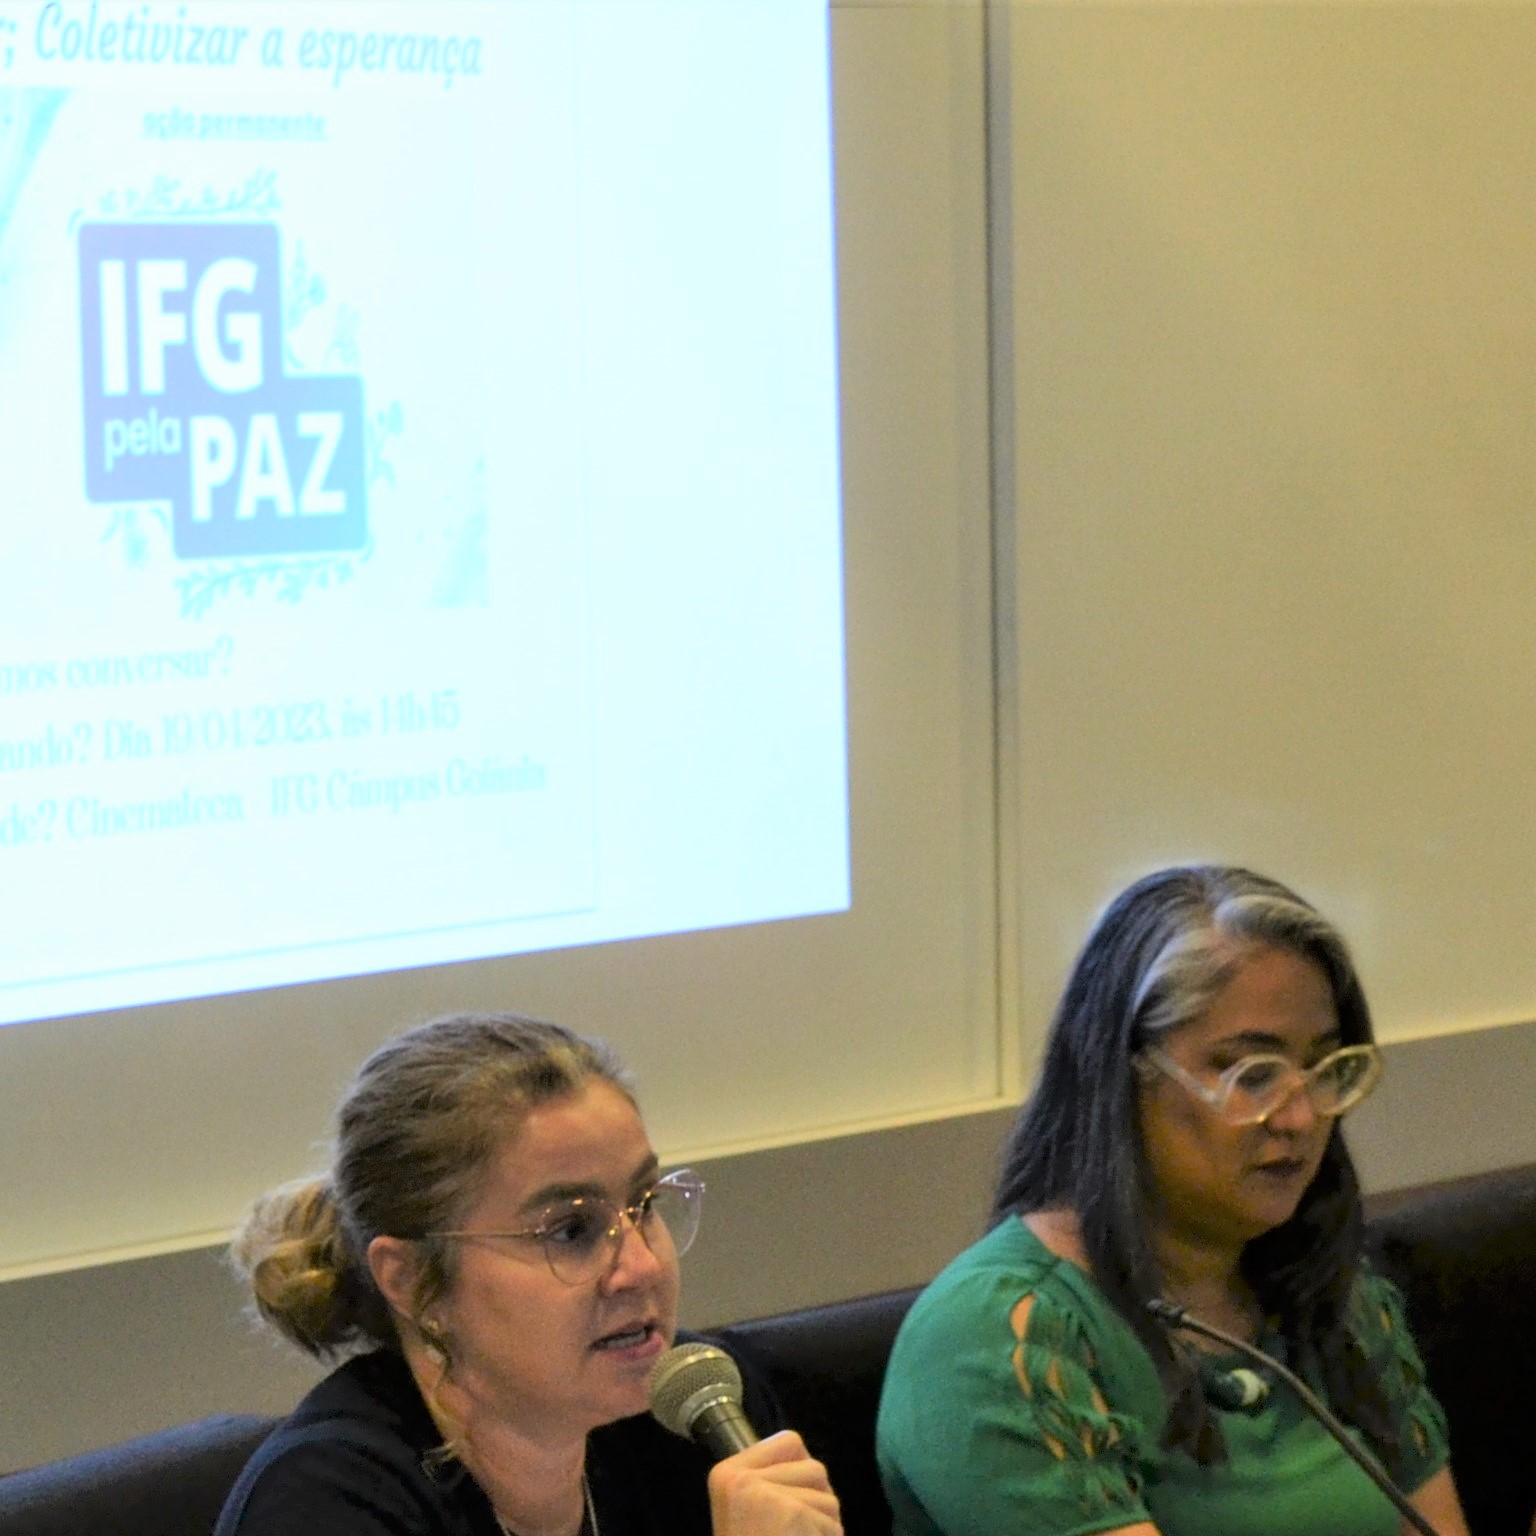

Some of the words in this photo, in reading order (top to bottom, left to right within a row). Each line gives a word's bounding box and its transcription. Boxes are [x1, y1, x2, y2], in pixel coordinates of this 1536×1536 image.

[34, 0, 248, 65] Coletivizar
[261, 25, 284, 67] a
[299, 25, 482, 90] esperança
[100, 256, 264, 396] IFG
[105, 408, 181, 472] pela
[190, 411, 347, 522] PAZ
[65, 634, 236, 689] conversar?
[103, 717, 153, 762] Dia
[65, 787, 244, 841] Cinemateca
